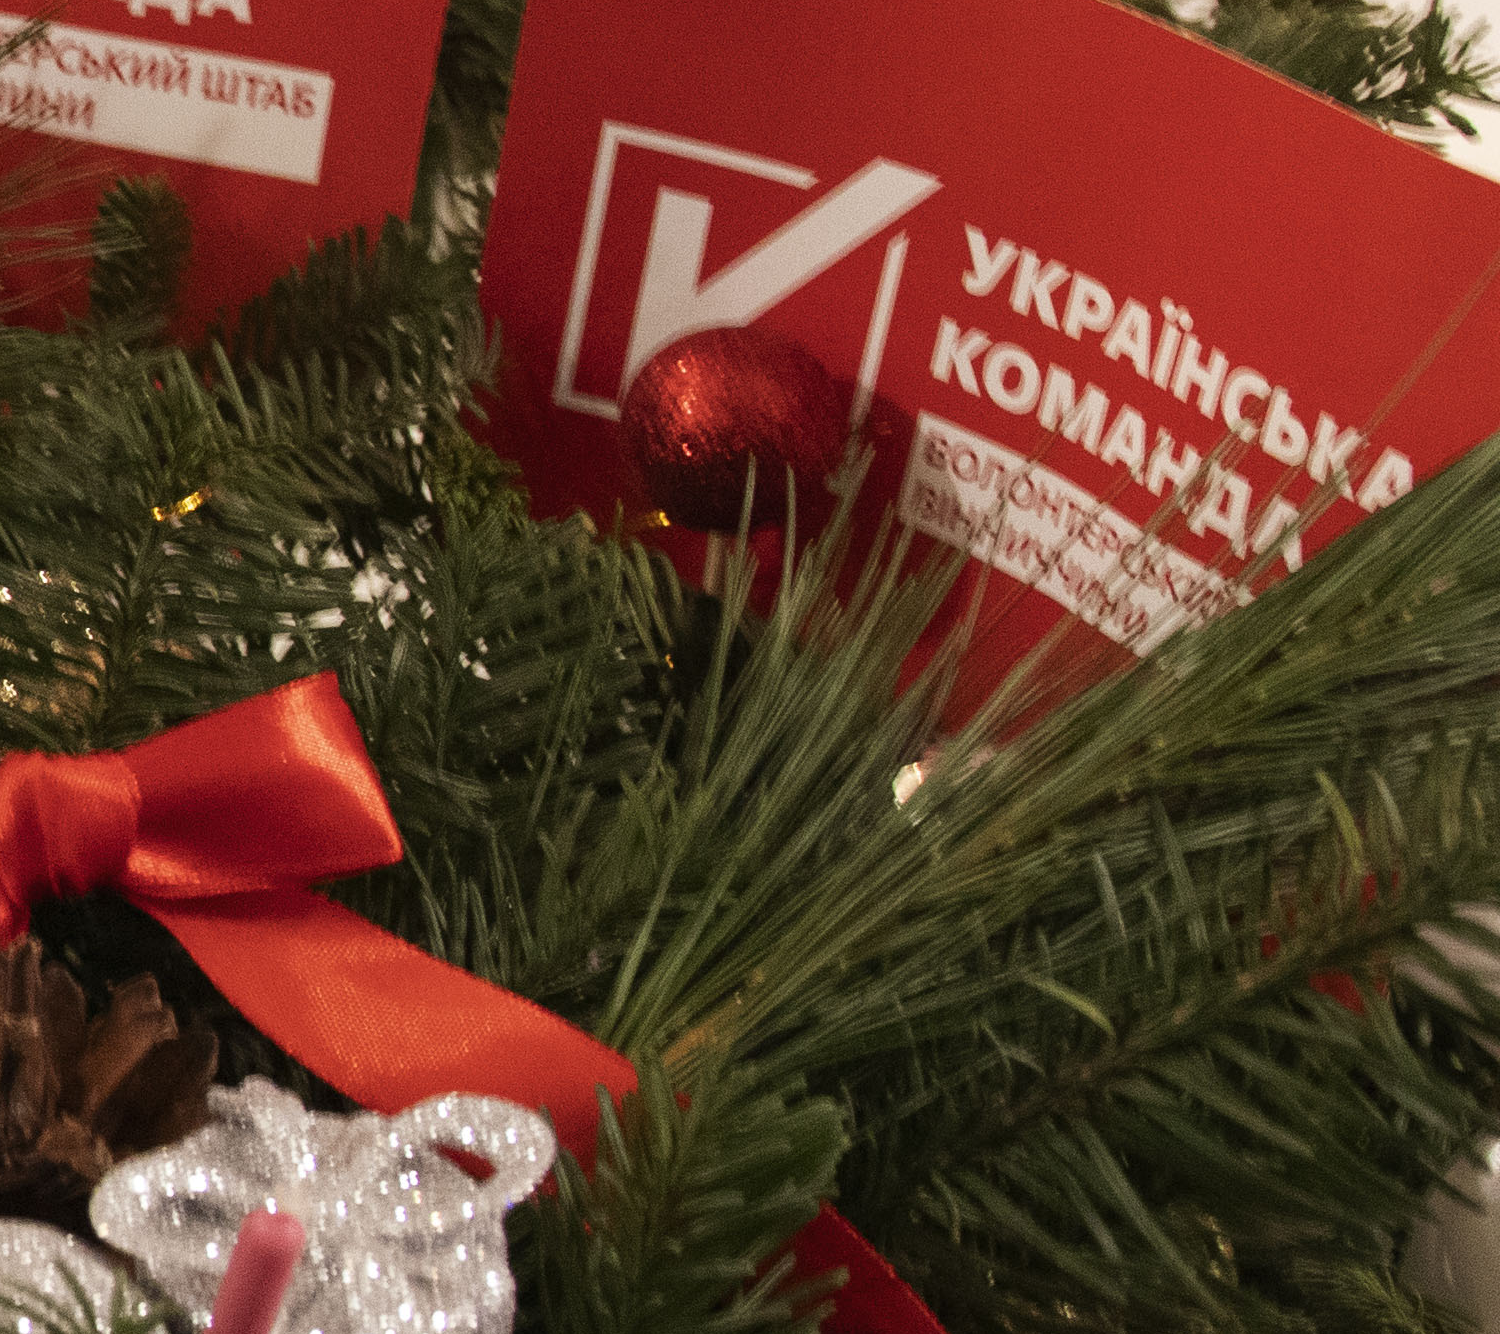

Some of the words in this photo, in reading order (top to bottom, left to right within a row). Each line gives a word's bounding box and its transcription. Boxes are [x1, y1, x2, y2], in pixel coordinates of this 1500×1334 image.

[200, 61, 317, 121] ШТАБ
[930, 315, 1304, 573] КОМАНДА
[961, 223, 1414, 514] УКРАЇНСЬКА
